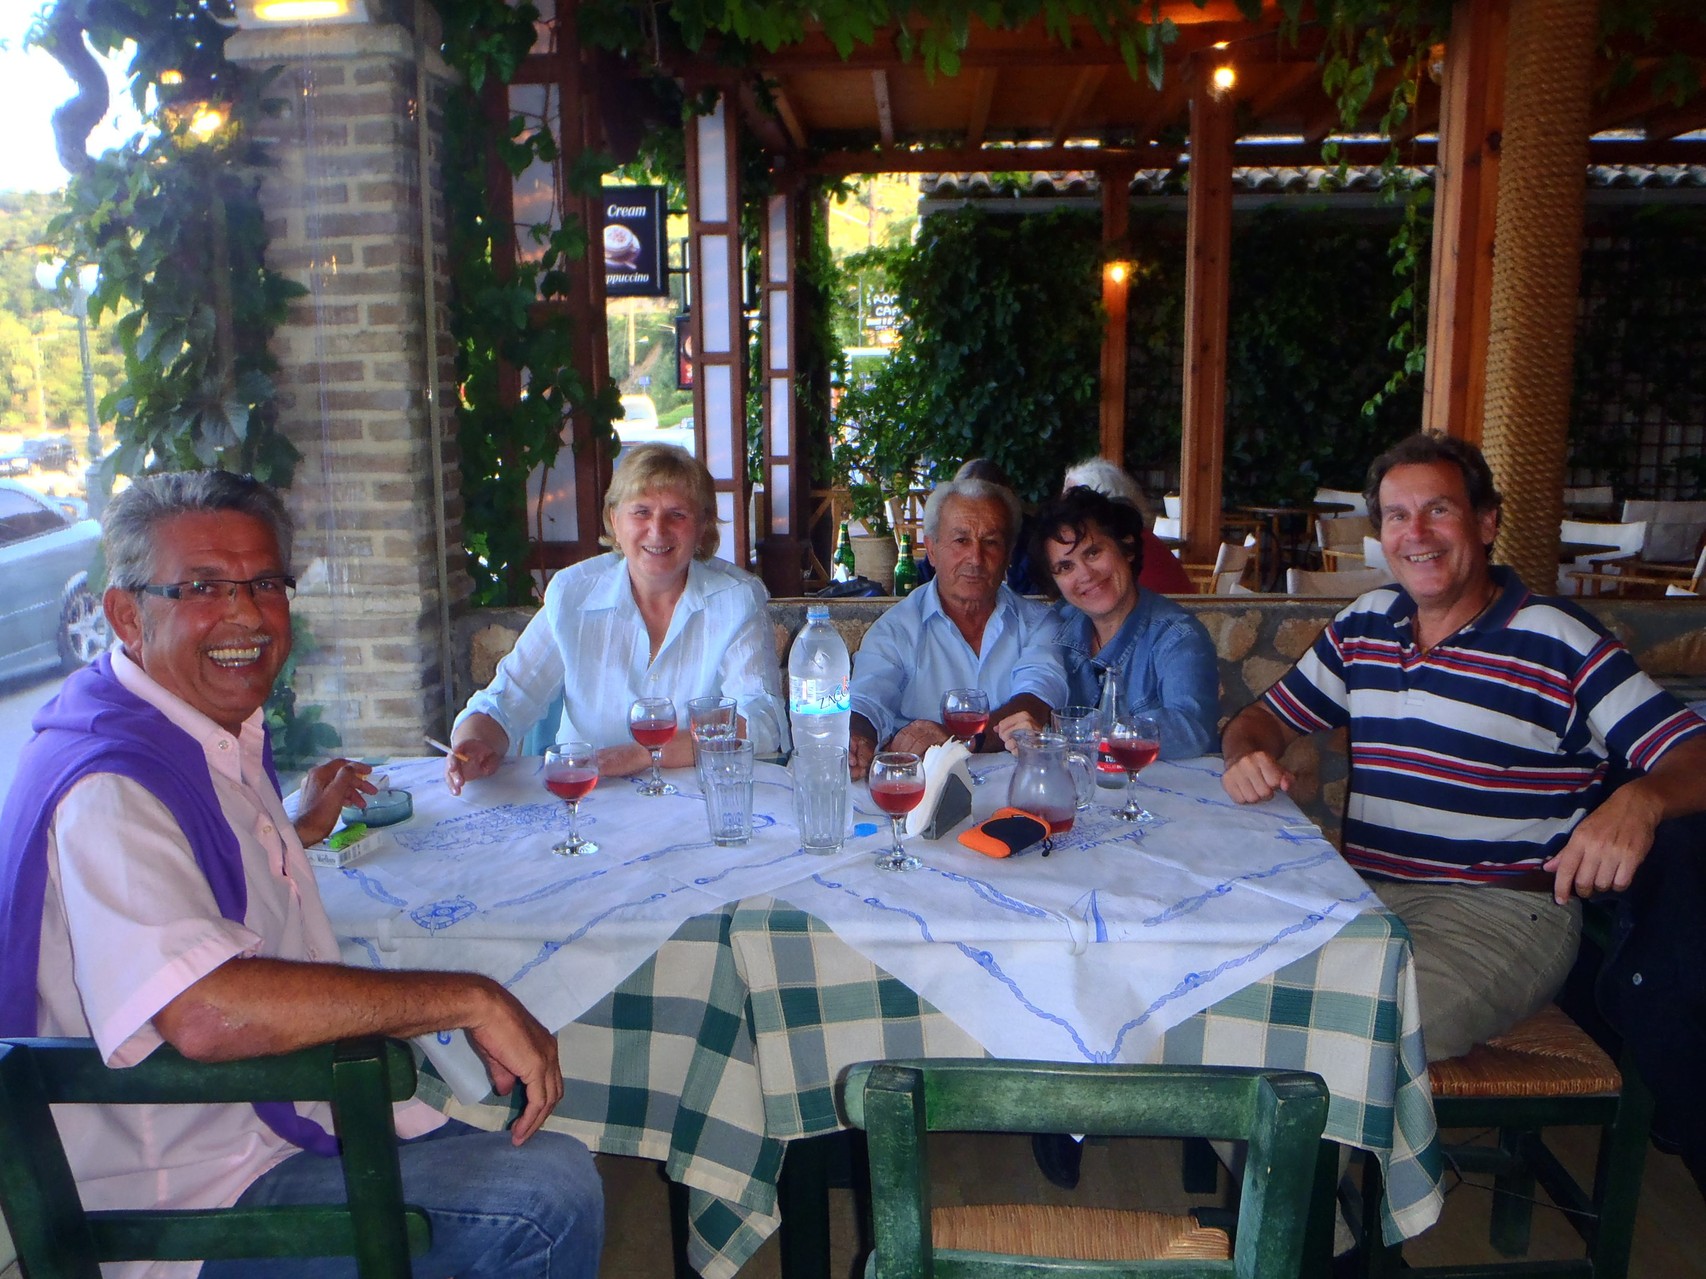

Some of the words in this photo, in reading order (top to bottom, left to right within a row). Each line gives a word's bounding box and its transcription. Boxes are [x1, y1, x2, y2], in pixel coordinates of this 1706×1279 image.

[606, 203, 647, 218] Cream
[604, 271, 650, 285] ppuccino
[1105, 755, 1116, 763] TU
